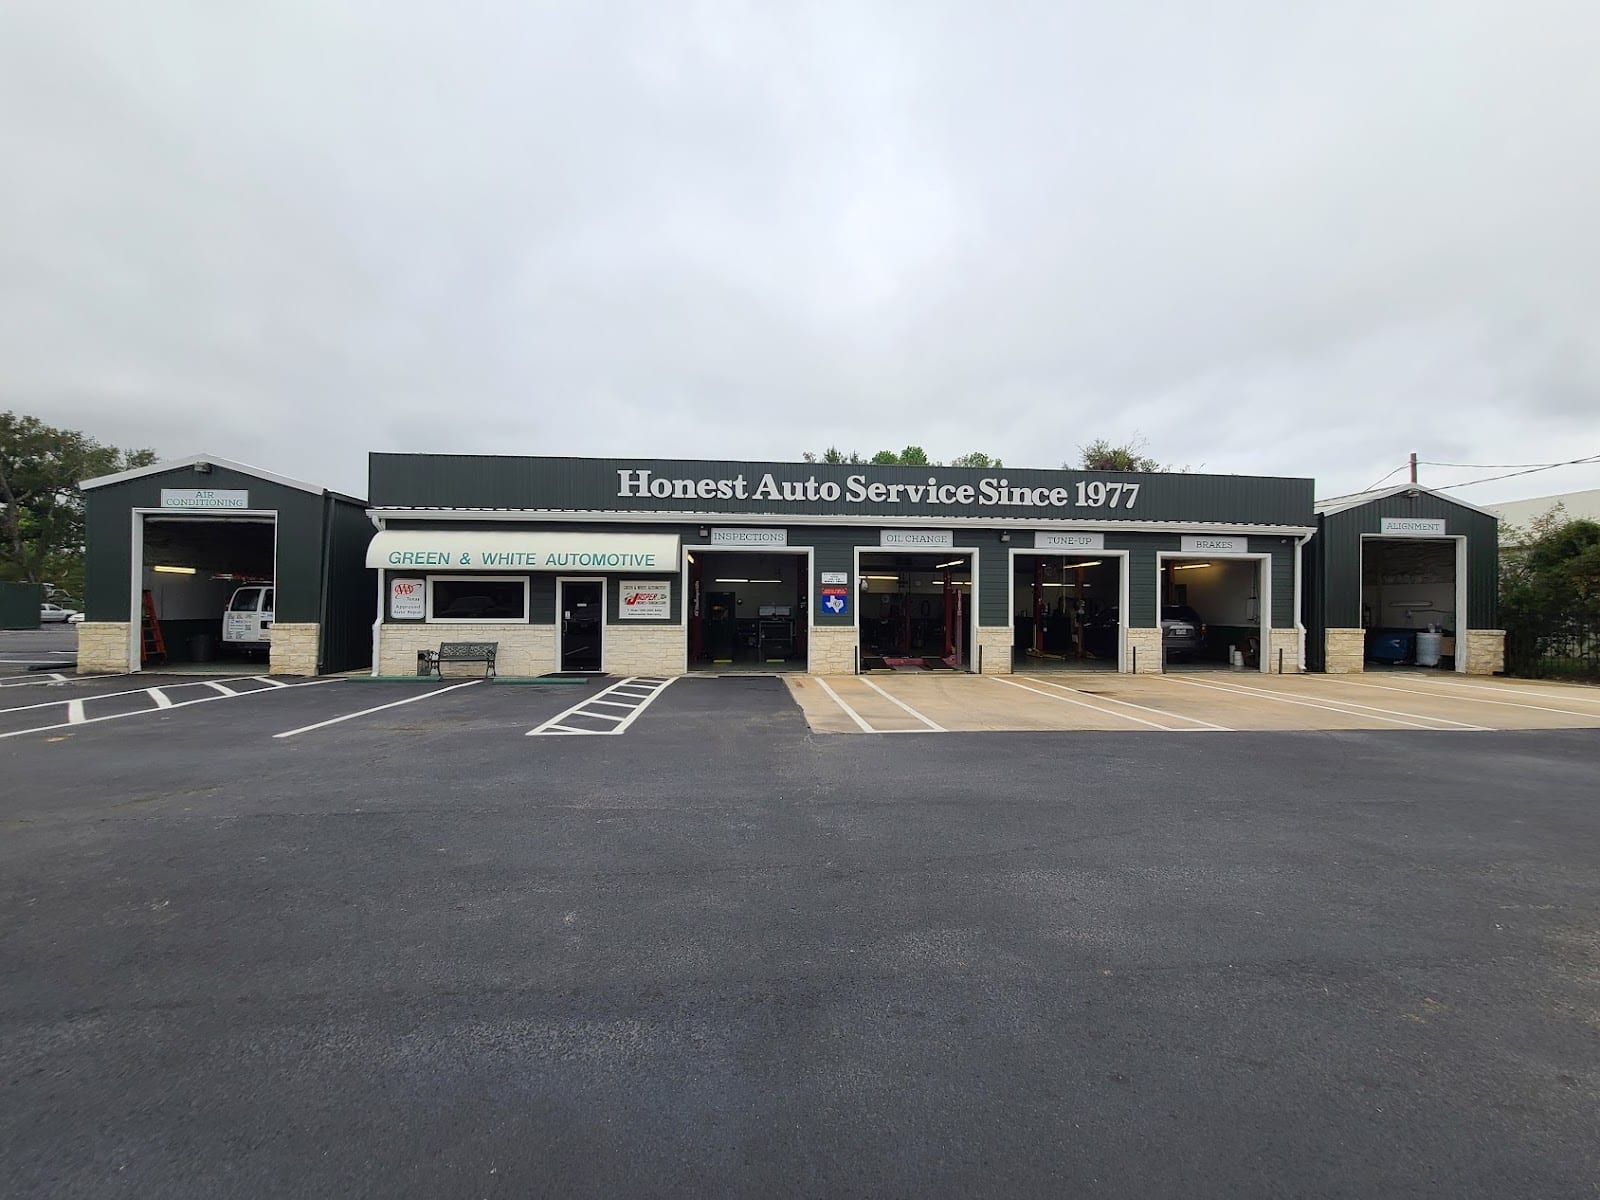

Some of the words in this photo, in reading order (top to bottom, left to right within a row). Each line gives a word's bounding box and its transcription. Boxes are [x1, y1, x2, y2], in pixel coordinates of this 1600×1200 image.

[617, 469, 748, 500] Honest
[751, 473, 840, 502] Auto
[845, 475, 976, 504] Service
[978, 478, 1068, 507] Since
[1075, 480, 1140, 509] 1977
[195, 491, 215, 499] AIR
[166, 498, 243, 507] CONDITIONING
[1385, 521, 1441, 531] ALIGNMENT
[713, 531, 785, 542] INSPECTIONS
[886, 534, 903, 543] OIL
[905, 534, 948, 544] CHANGE
[1047, 536, 1093, 545] TUNE-UP
[1195, 540, 1234, 550] BRAKES
[388, 551, 451, 565] GREEN
[459, 552, 472, 565] &
[482, 552, 537, 566] WHITE
[545, 553, 656, 567] AUTOMOTIVE
